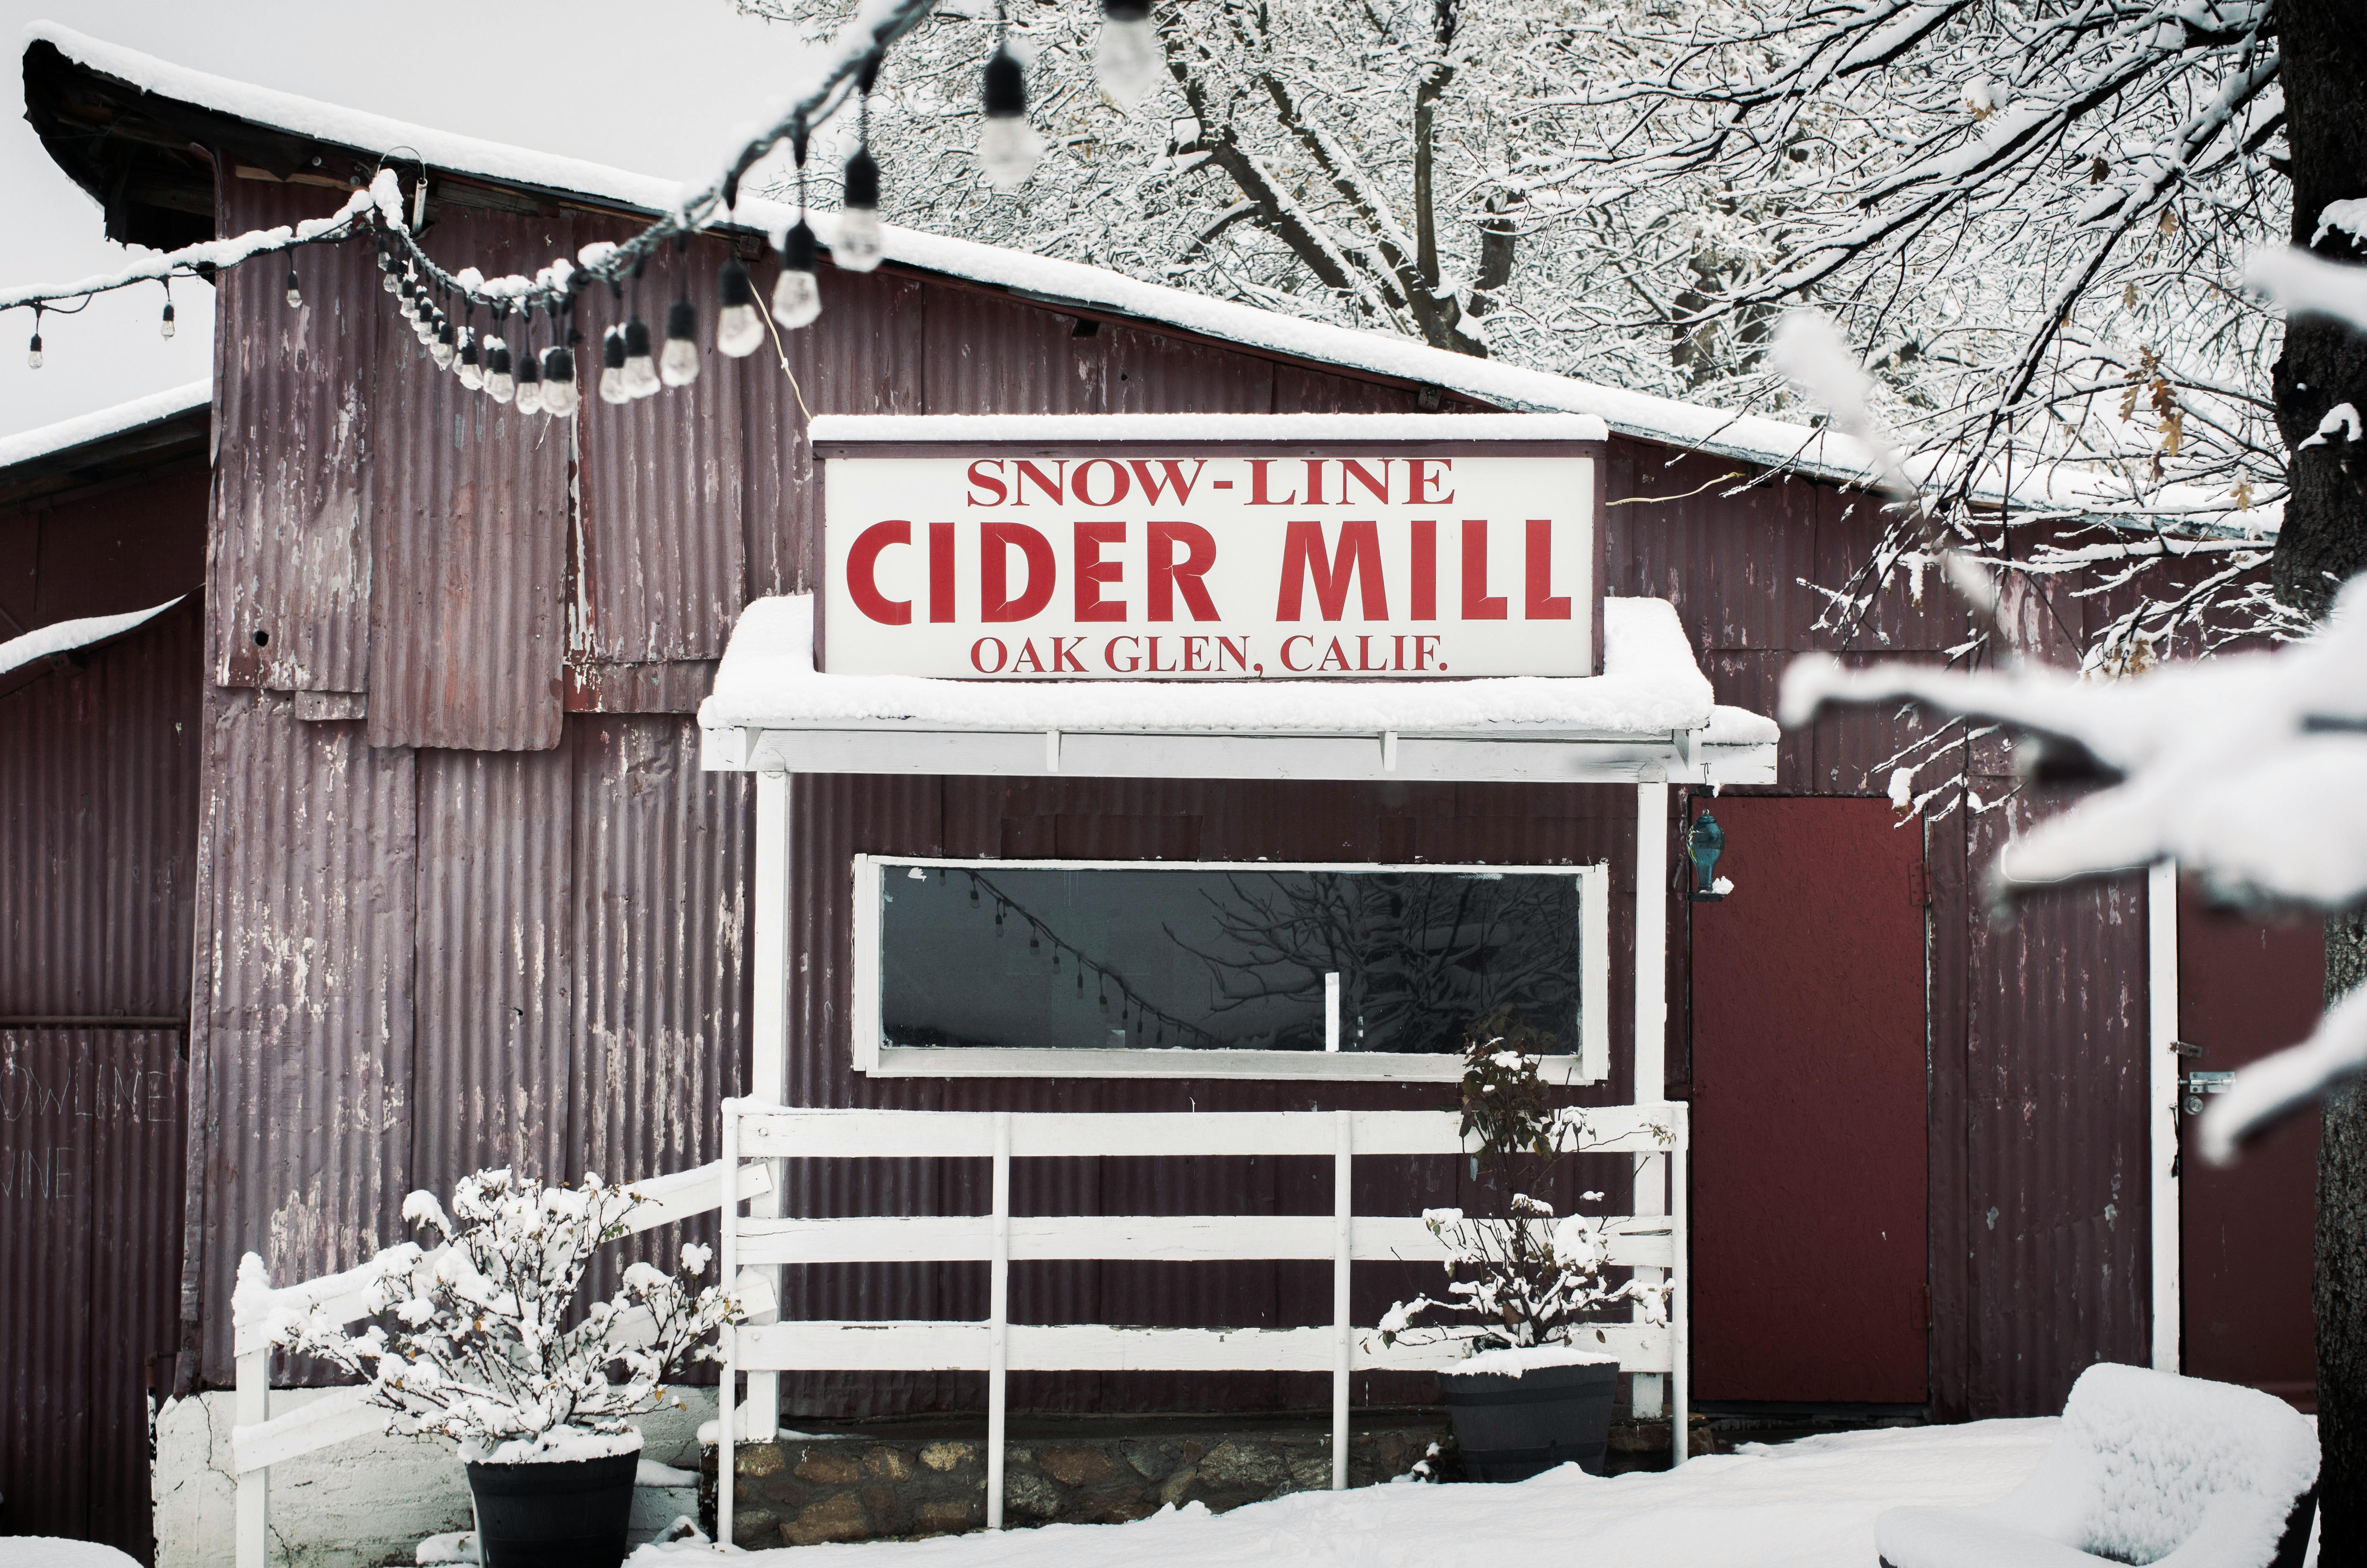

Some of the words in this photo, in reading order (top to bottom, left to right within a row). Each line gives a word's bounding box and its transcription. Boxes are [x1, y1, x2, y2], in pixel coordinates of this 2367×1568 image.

[968, 459, 1455, 506] SNOW-LINE
[847, 520, 1220, 625] CIDER
[1276, 520, 1571, 621] MILL
[971, 637, 1088, 672] OAK
[1105, 636, 1263, 677] GLEN,
[1281, 635, 1448, 672] CALIF.
